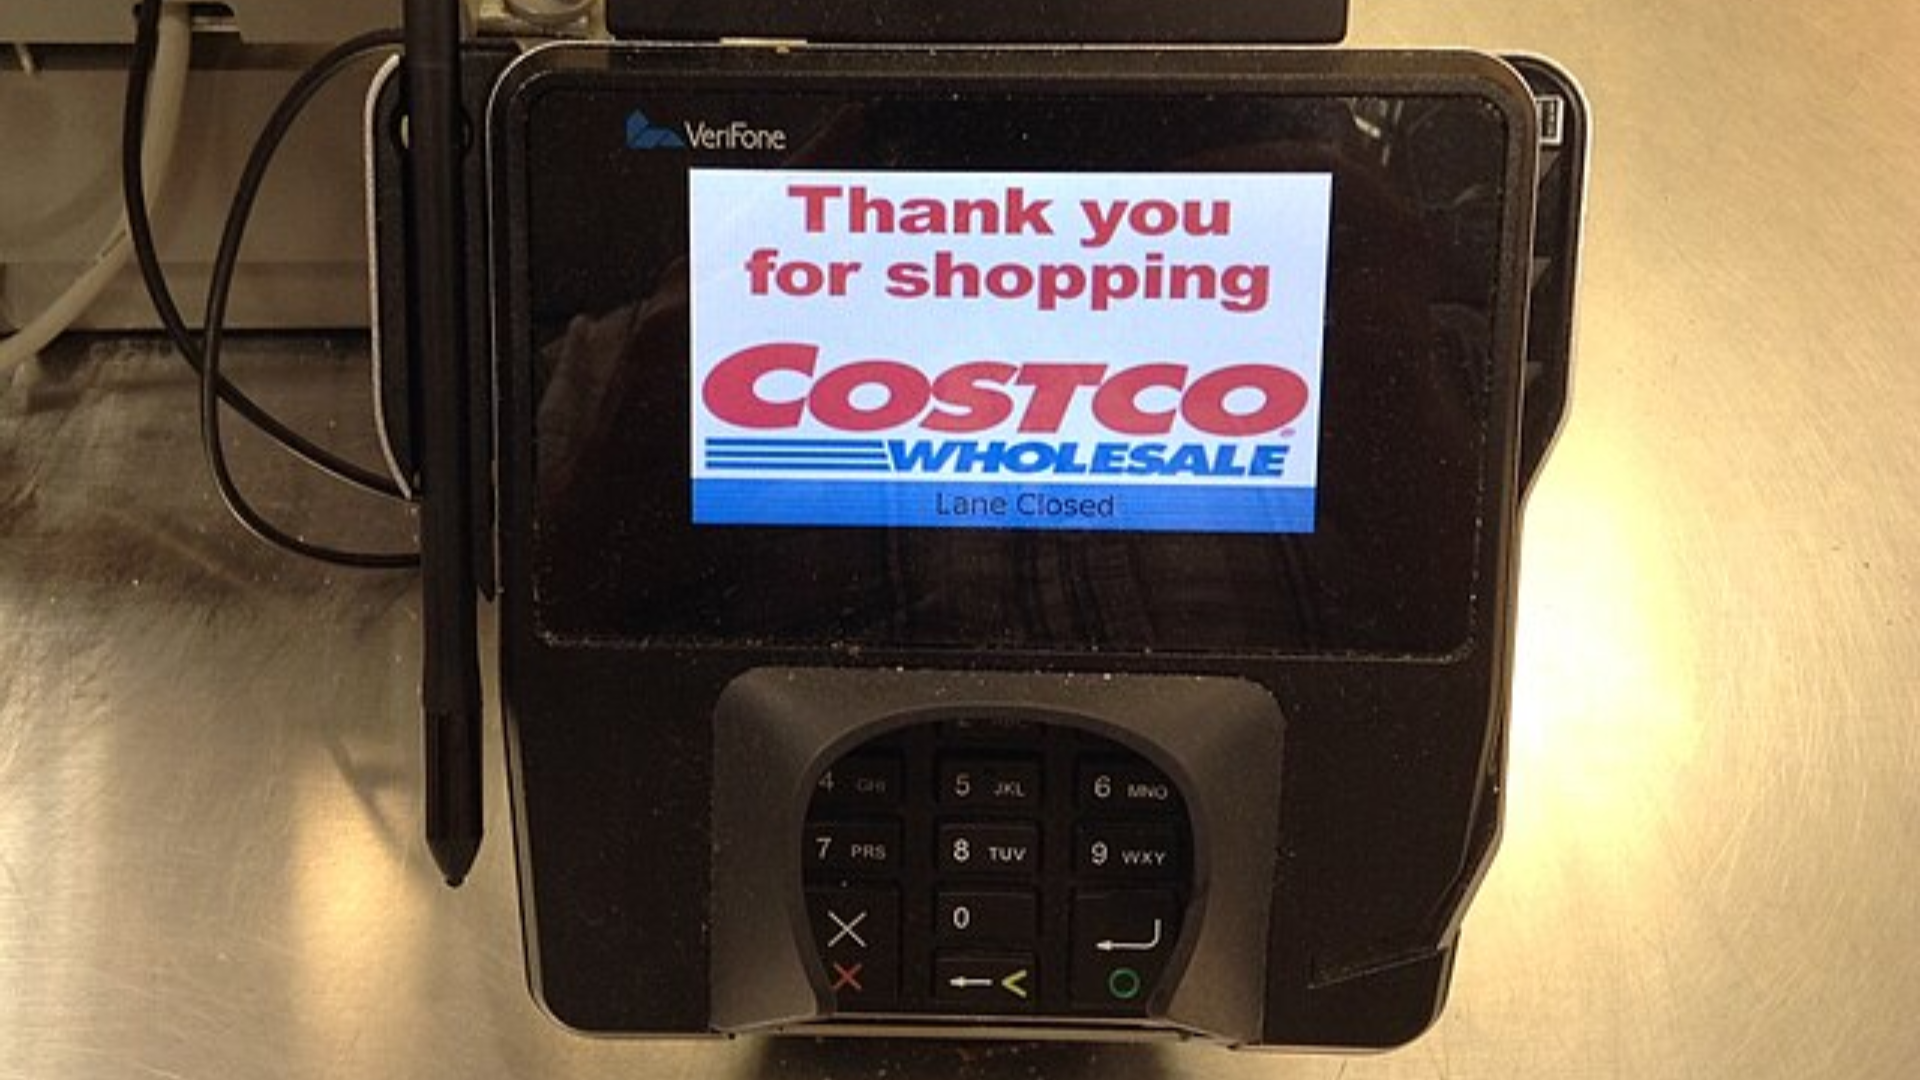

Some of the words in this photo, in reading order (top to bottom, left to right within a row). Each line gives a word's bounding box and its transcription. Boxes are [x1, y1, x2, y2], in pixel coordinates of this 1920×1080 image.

[684, 120, 786, 151] VeriFone
[788, 184, 1053, 236] Thank
[1081, 199, 1231, 247] you
[746, 250, 862, 297] for
[885, 251, 1271, 312] shopping
[702, 342, 1310, 436] COSTCO
[888, 439, 1291, 477] WHOLESALE
[936, 493, 1008, 516] Lane
[1016, 493, 1115, 518] Closed
[818, 771, 834, 792] 4
[955, 774, 970, 797] 5
[993, 784, 1025, 797] JKL
[1094, 776, 1111, 799] 6
[1127, 784, 1168, 800] MNO
[816, 837, 832, 859] 7
[851, 844, 886, 860] PRS
[953, 838, 970, 862] 8
[989, 846, 1026, 862] TUV
[1091, 841, 1108, 865] 9
[1122, 850, 1167, 866] WXY
[953, 906, 970, 929] 0
